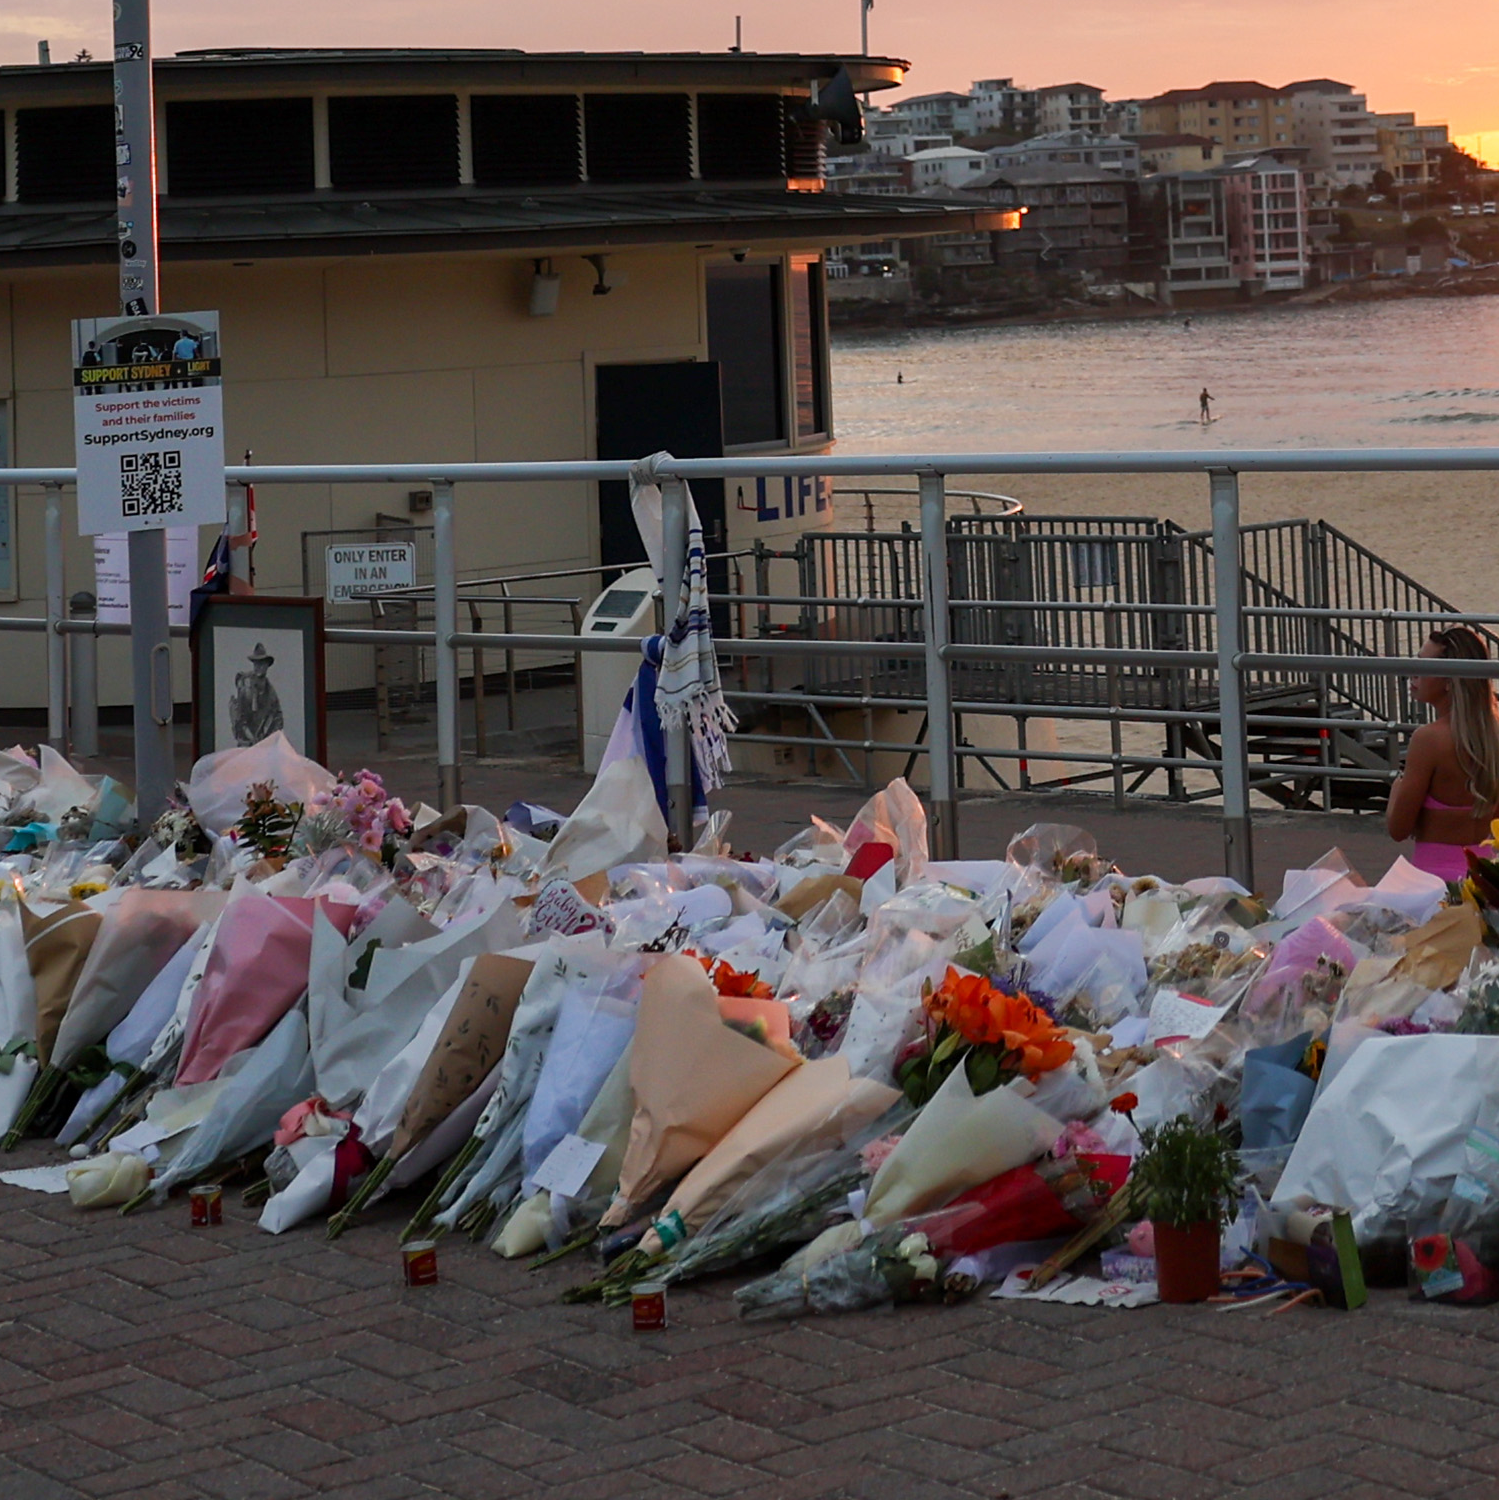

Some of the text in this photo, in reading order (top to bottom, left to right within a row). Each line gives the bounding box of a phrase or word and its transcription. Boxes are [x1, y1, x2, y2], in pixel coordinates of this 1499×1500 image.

[82, 367, 129, 382] SUPPORT
[131, 364, 171, 378] SYDNEY
[95, 396, 201, 412] Support the victims
[102, 411, 196, 427] and their families
[84, 426, 214, 446] SupportSydney.org
[756, 477, 832, 522] LIFE
[334, 549, 406, 563] ONLY ENTER
[355, 567, 387, 579] IN AN
[546, 889, 578, 920] Baby
[535, 903, 578, 934] Girl
